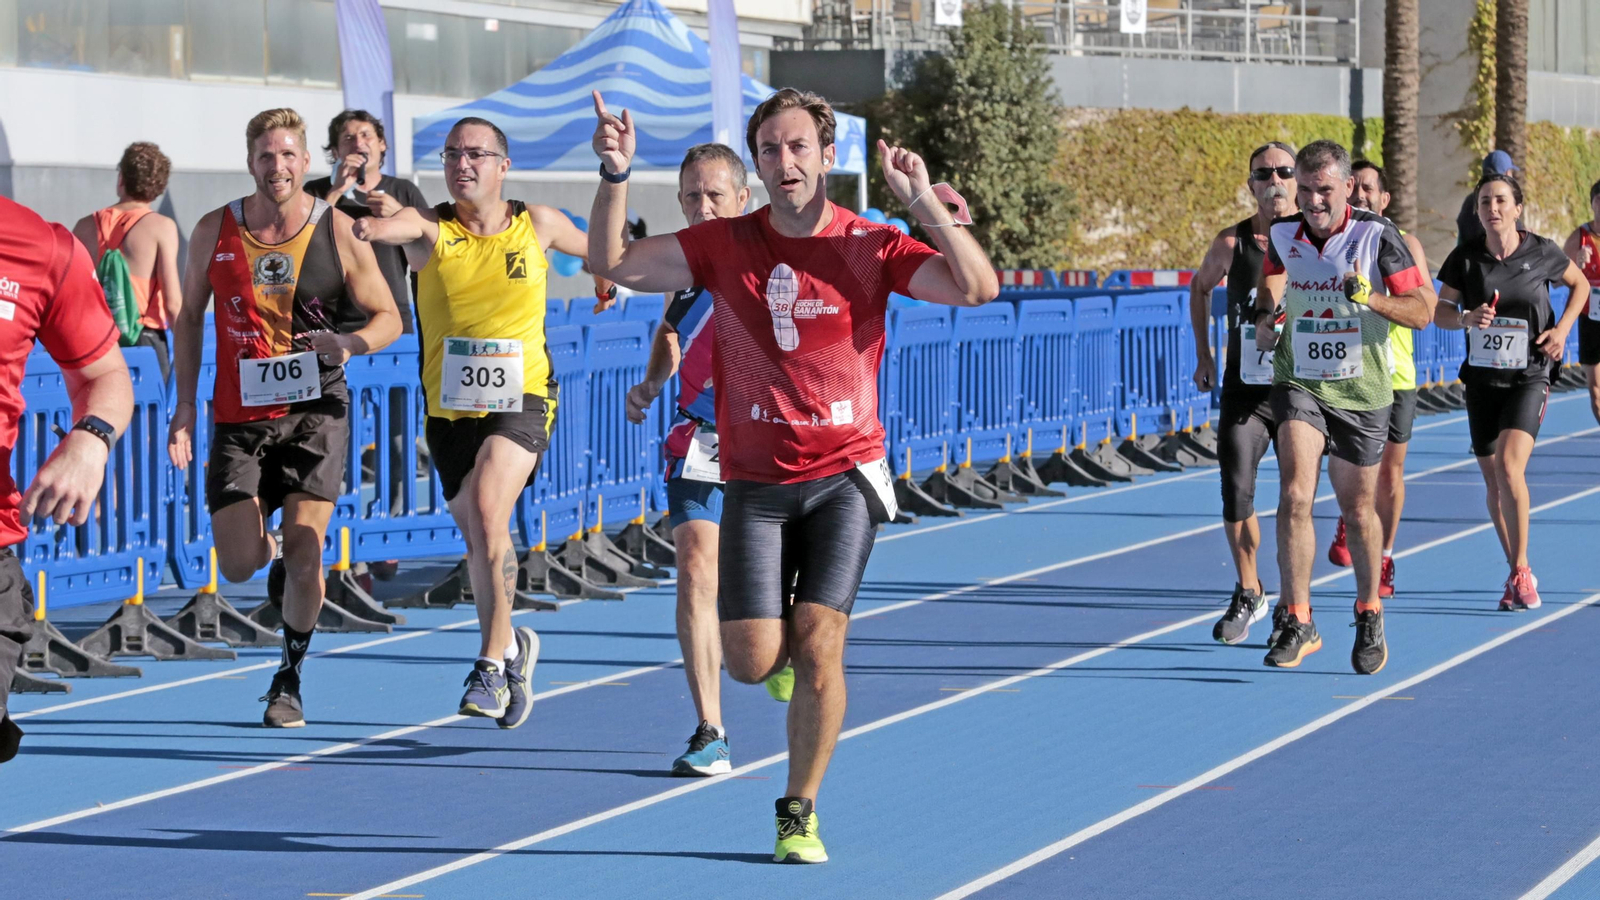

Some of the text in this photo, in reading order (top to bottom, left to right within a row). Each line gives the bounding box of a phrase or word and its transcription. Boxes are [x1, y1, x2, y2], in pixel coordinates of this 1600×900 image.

[773, 302, 788, 312] 38
[1308, 341, 1347, 360] 868
[1483, 334, 1515, 350] 297
[257, 359, 303, 383] 706
[461, 366, 505, 388] 303
